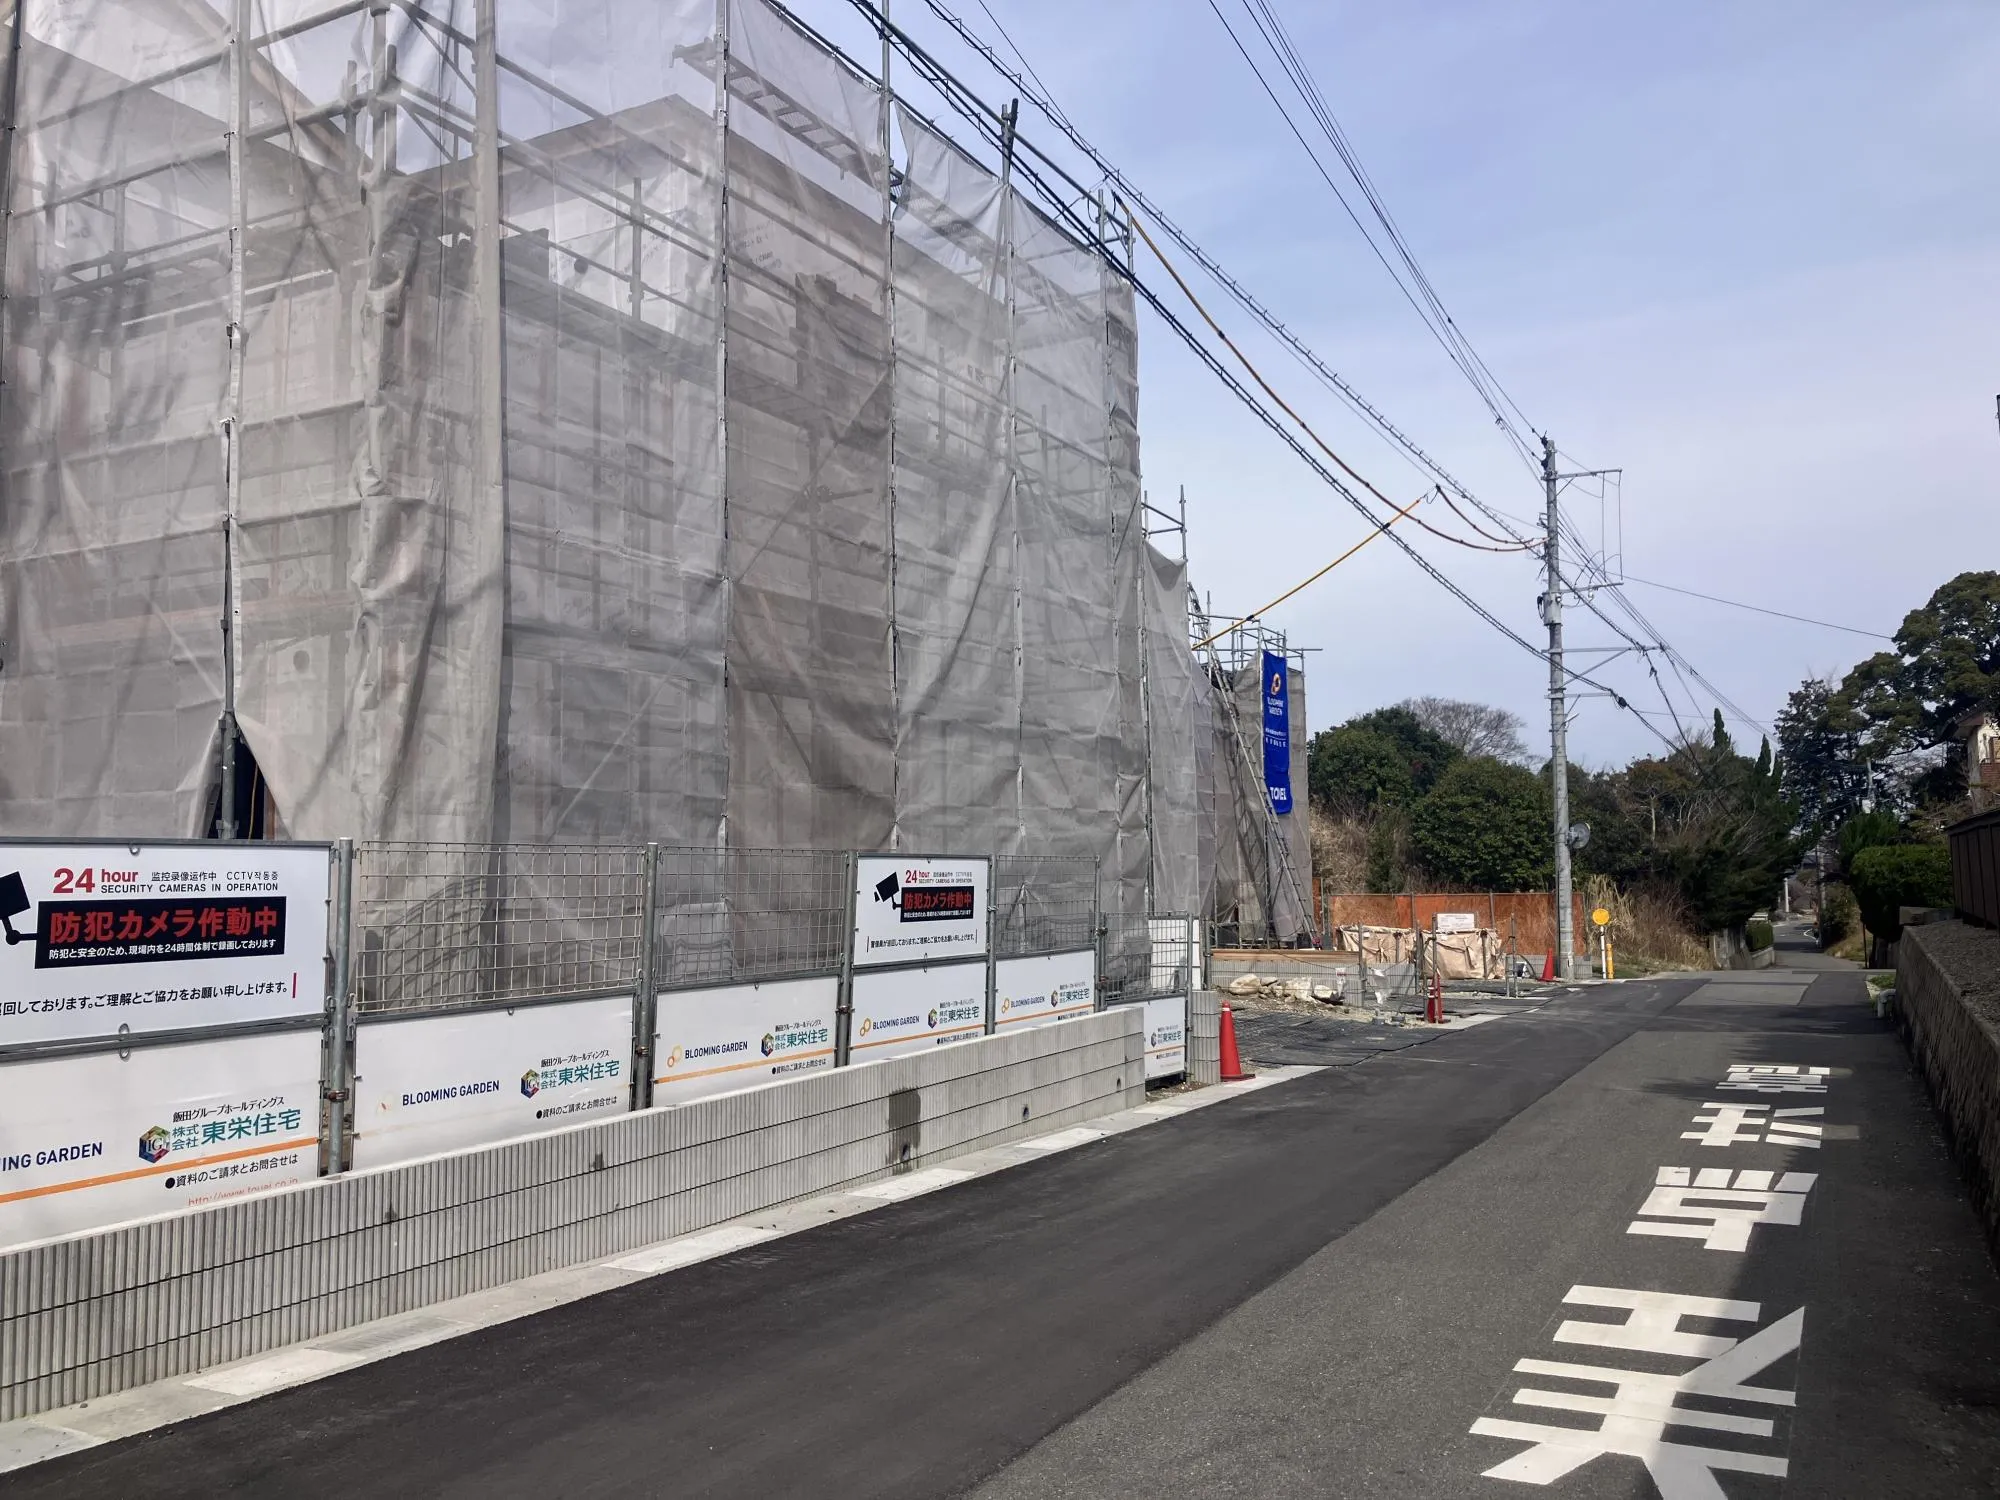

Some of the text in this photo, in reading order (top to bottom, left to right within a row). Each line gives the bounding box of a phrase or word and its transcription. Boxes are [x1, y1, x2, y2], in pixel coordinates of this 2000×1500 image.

[53, 868, 95, 894] 24
[101, 869, 139, 883] hour
[151, 871, 217, 882] 监控录像运作中
[905, 869, 917, 884] 24
[101, 883, 279, 893] SECURITY CAMERAS IN OPERATION
[904, 891, 972, 910] 防犯カメラ作動中
[49, 906, 278, 945] 防犯カメラ作動中
[0, 982, 288, 1015] 回しております。ご理解とご協力をお願い申し上げます。
[872, 1015, 920, 1030] BLOOMING GARDEN
[948, 1006, 980, 1021] 東栄住宅
[787, 1028, 828, 1048] 東栄住宅
[684, 1041, 748, 1060] BLOOMING GARDEN
[541, 1069, 557, 1079] 株式
[558, 1060, 620, 1086] 東栄住宅
[402, 1080, 500, 1106] BLOOMING GARDEN
[541, 1080, 557, 1090] 会社
[172, 1096, 285, 1123] 飯田グループホールディングス
[172, 1124, 199, 1138] 株式
[201, 1109, 302, 1145] 東栄住宅
[172, 1137, 199, 1150] 会社
[0, 1142, 103, 1171] ING GARDEN
[176, 1154, 298, 1188] 資料のご請求とお問合せは
